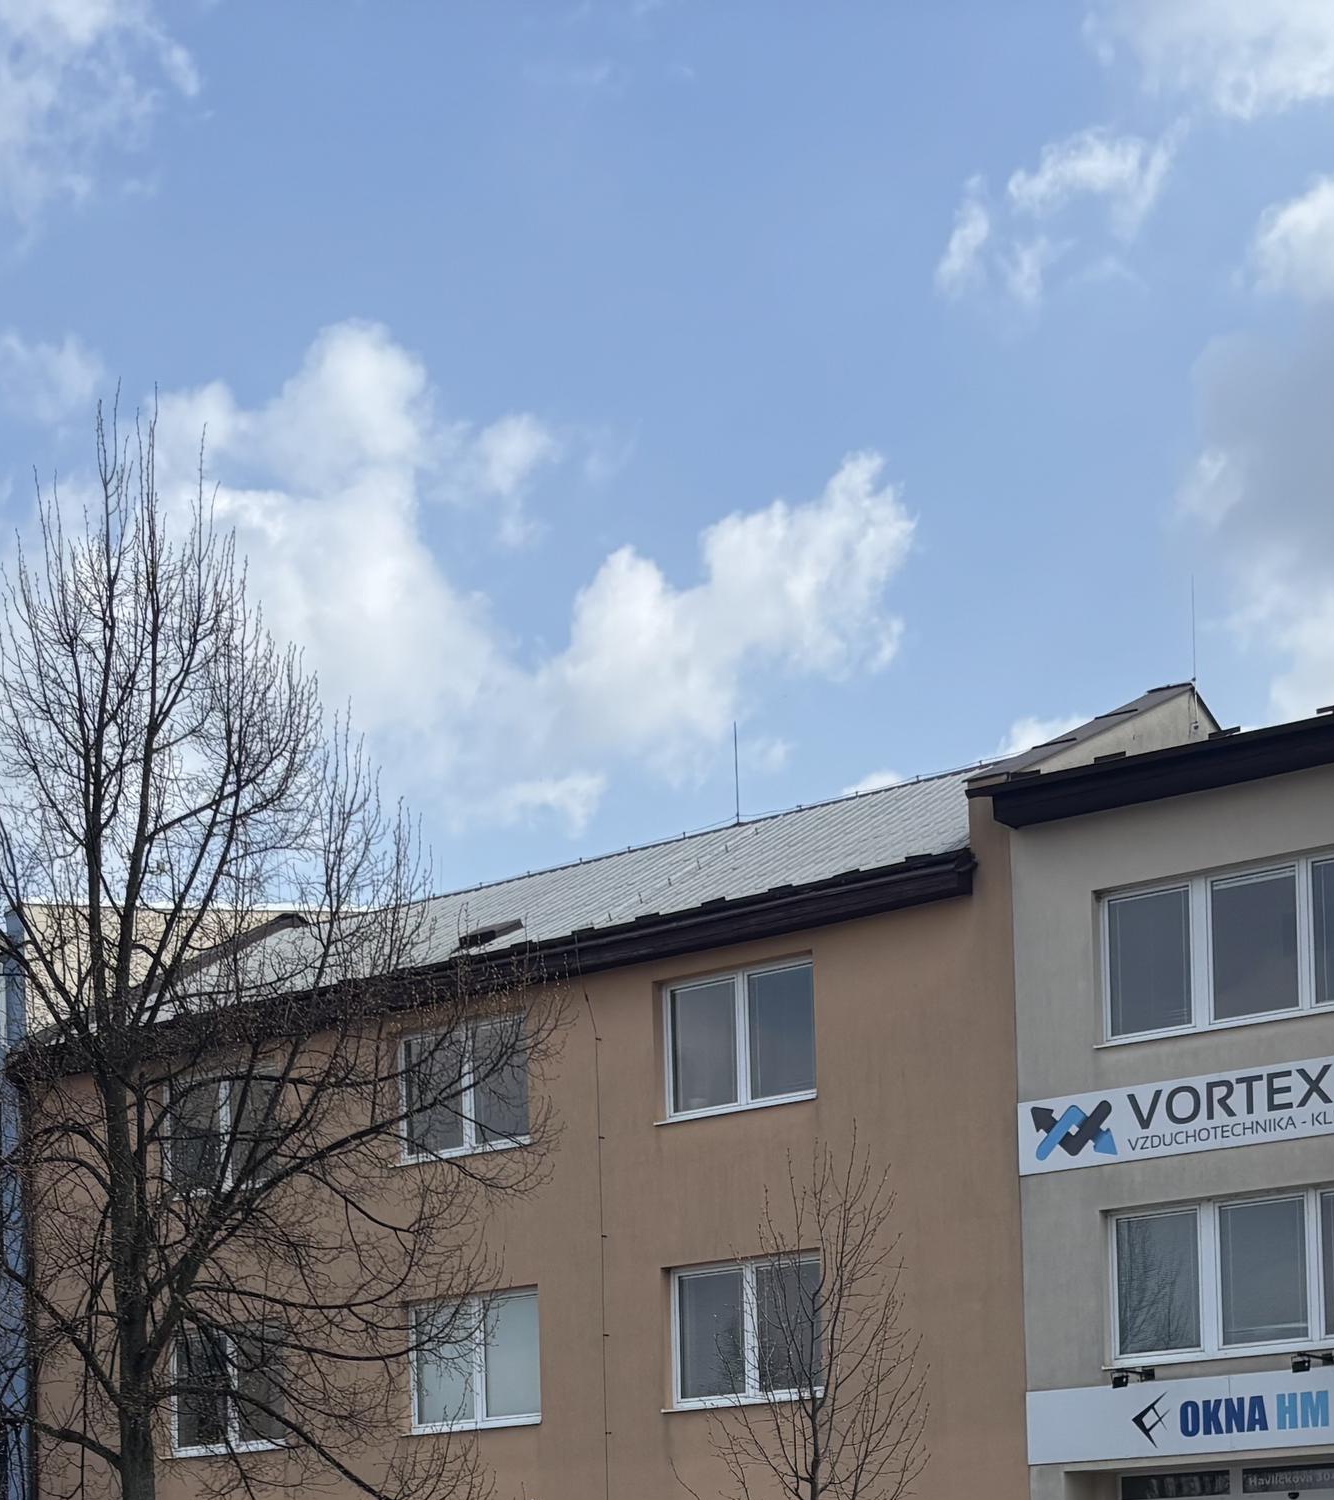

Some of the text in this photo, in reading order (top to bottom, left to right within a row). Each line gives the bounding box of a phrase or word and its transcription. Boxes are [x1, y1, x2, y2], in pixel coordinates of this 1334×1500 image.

[1127, 1115, 1297, 1151] VZDUCHOTECHNIKA
[1179, 1390, 1329, 1437] OKNA HM
